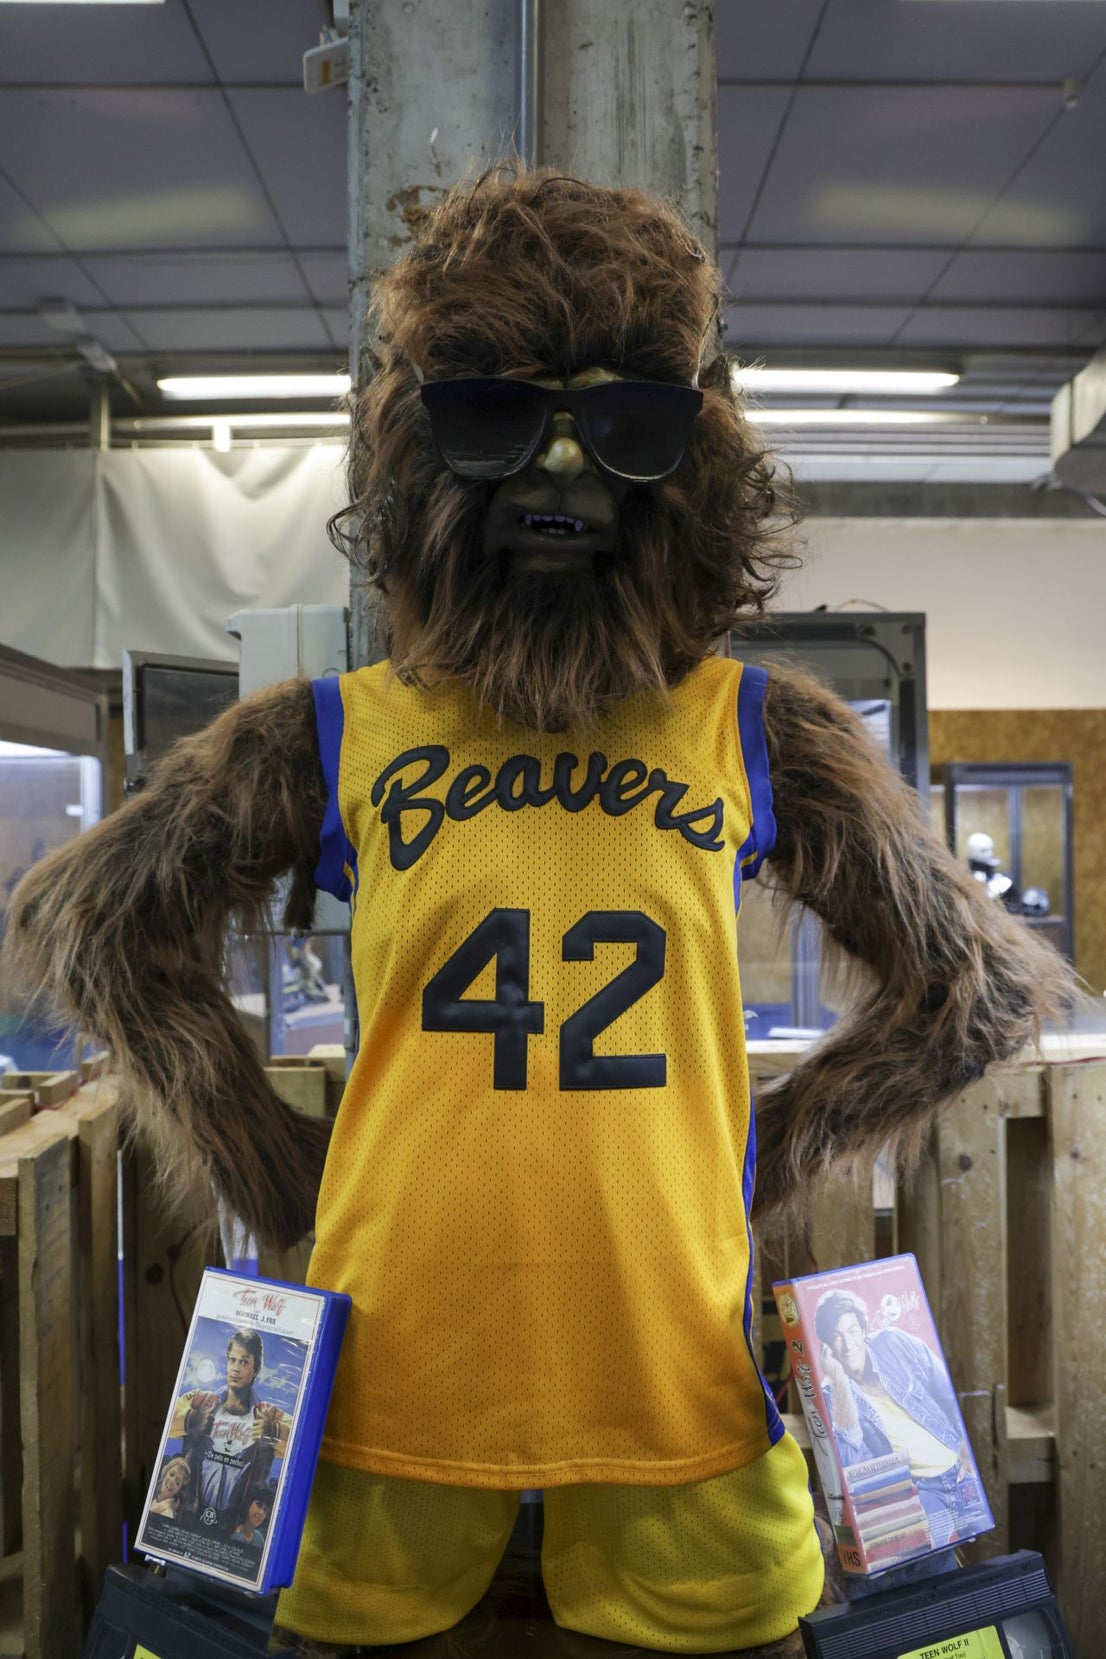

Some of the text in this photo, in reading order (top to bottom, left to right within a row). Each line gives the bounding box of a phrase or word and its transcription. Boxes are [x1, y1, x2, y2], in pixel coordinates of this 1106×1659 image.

[371, 745, 725, 871] Beavers
[422, 907, 667, 1091] 42
[233, 1289, 287, 1316] Teen Wolf
[235, 1309, 259, 1321] MICHAEL
[791, 1340, 829, 1457] Teen Wolf 2
[843, 1549, 861, 1567] VHS
[919, 1648, 940, 1659] TEEN
[940, 1640, 962, 1654] WOLF
[963, 1638, 970, 1647] II
